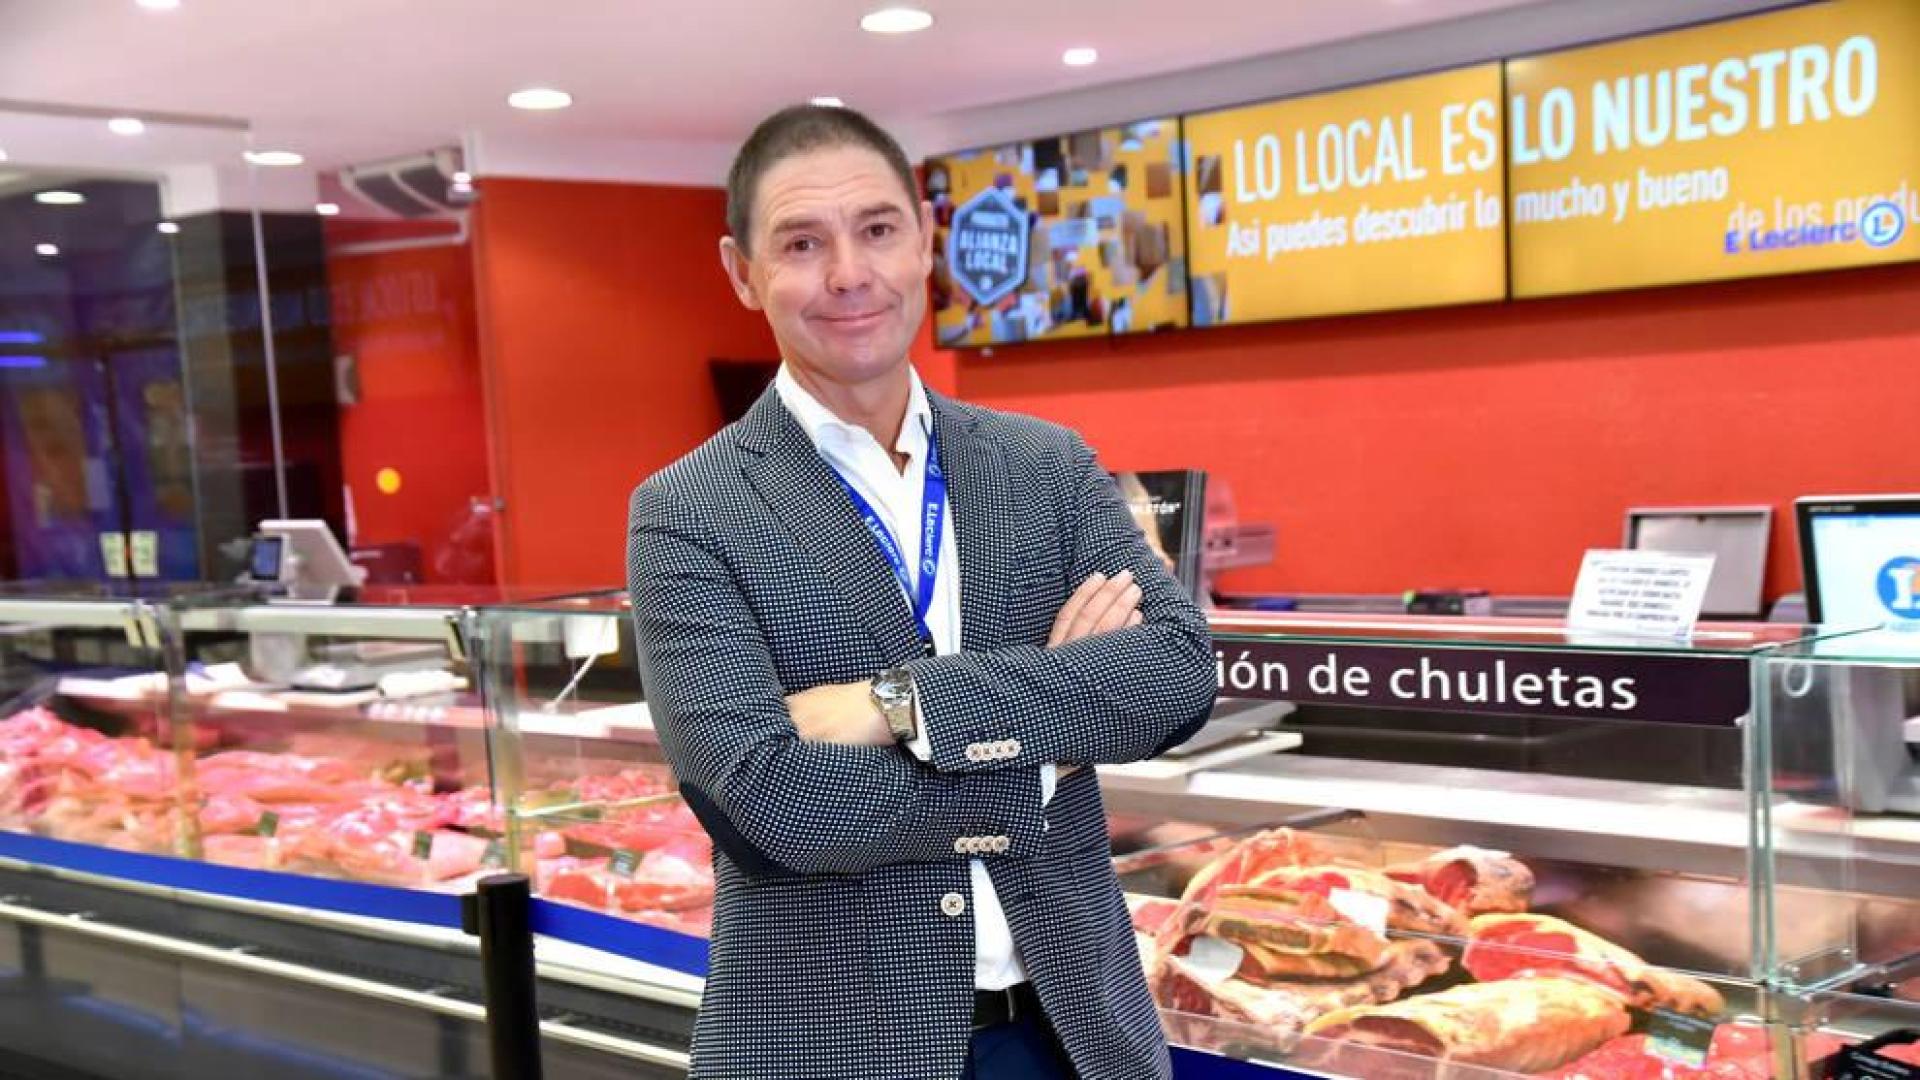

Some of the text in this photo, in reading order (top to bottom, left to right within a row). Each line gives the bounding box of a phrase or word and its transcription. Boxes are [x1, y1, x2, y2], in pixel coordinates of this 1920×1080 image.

[1234, 36, 1877, 203] LO LOCAL ES LO NUESTRO
[1266, 209, 1347, 262] puedes
[1354, 196, 1467, 244] descubrir
[1474, 188, 1500, 229] lo
[1514, 177, 1603, 225] mucho
[1612, 184, 1629, 224] y
[1637, 167, 1728, 207] bueno
[1308, 653, 1371, 696] de
[1389, 657, 1638, 711] chuletas
